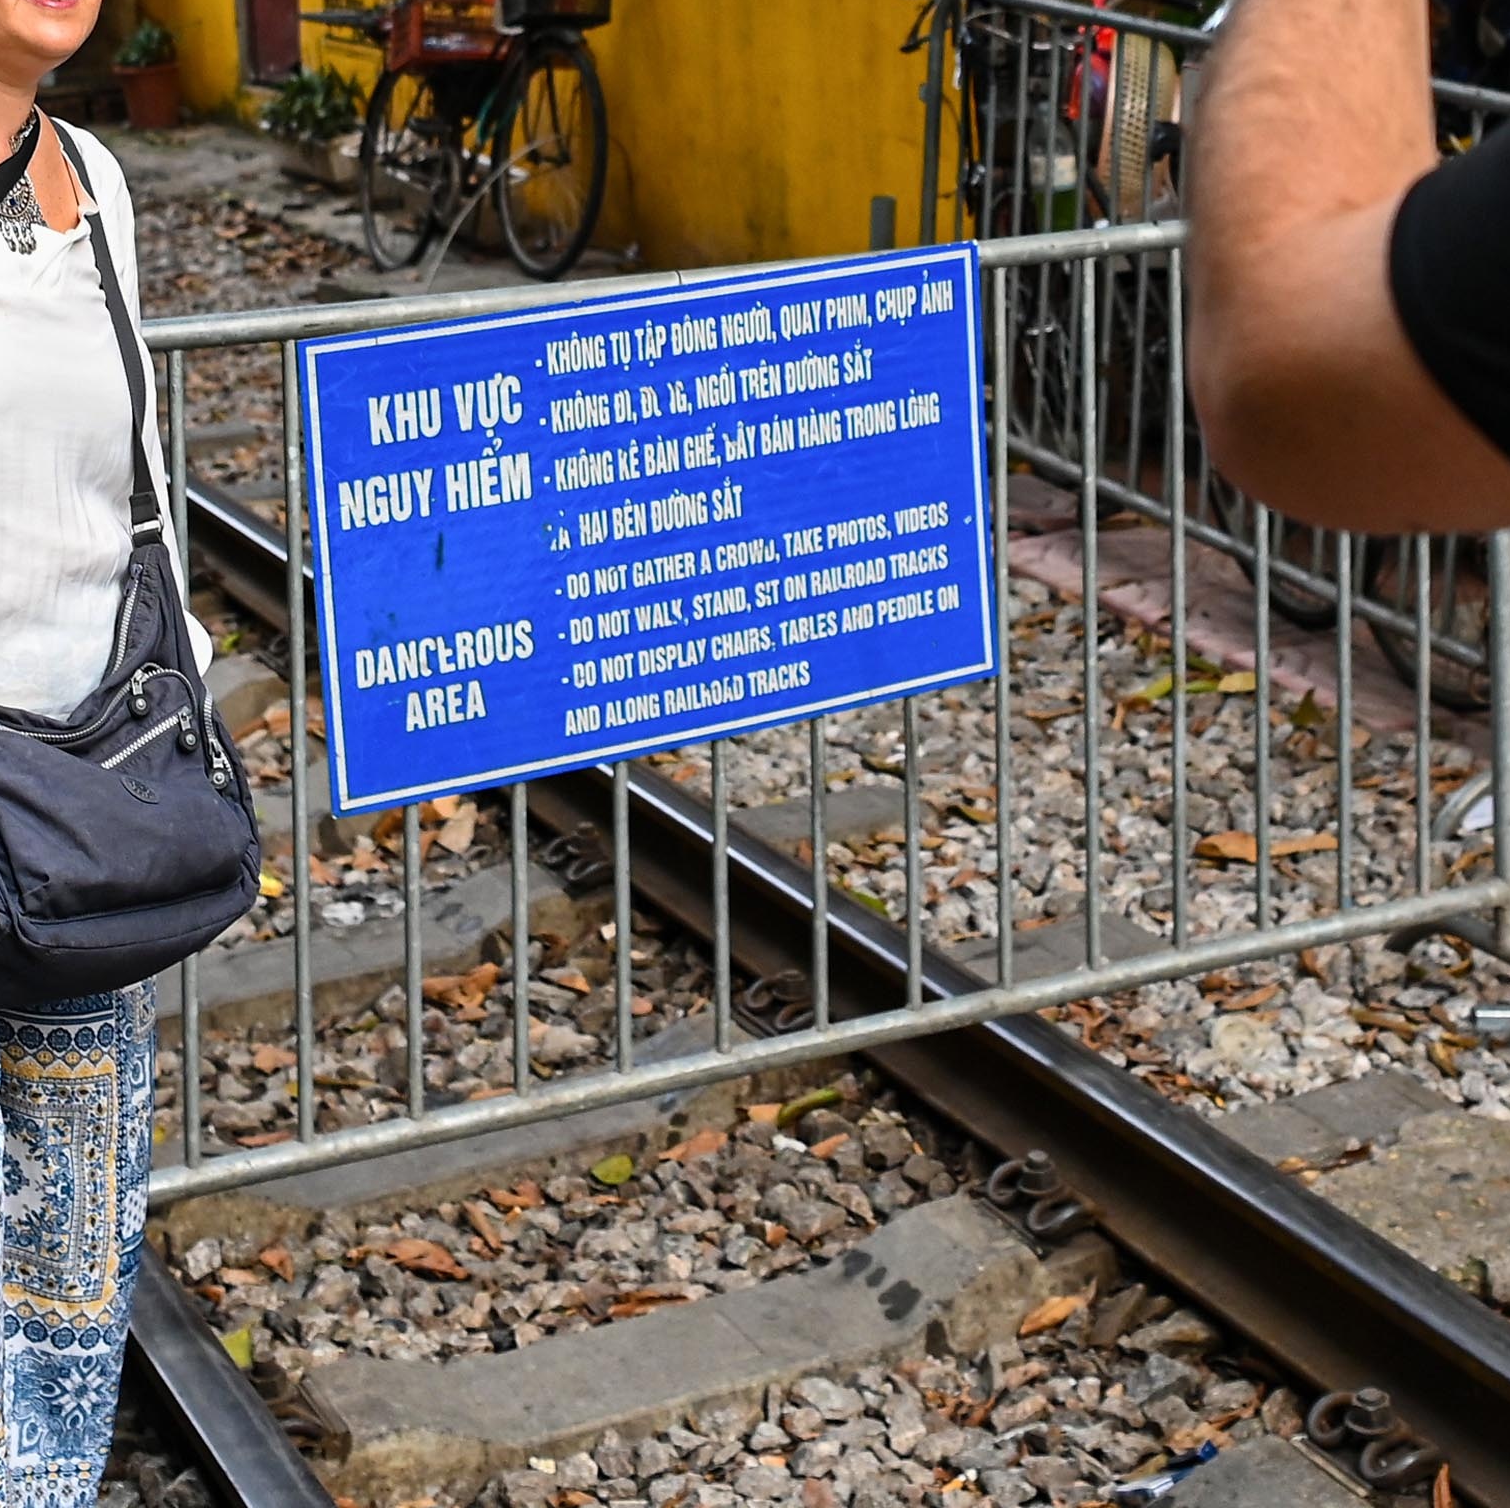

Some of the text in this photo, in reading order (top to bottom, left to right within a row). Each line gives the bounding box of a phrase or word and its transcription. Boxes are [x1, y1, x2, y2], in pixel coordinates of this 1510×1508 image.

[546, 331, 607, 376] KHÔNG
[609, 330, 632, 371] TỤ
[634, 319, 667, 368] TẬP
[670, 314, 718, 356] ĐÔNG
[779, 300, 822, 341] QUAY
[825, 293, 873, 331] PHIM,
[875, 285, 917, 326] CHỤP
[921, 269, 954, 315] ẢNH
[368, 372, 523, 446] KHU VỰC
[550, 389, 611, 434] KHÔNG
[695, 362, 737, 410] NGỒI
[738, 359, 782, 402] TRÊN
[784, 350, 840, 394] ĐƯỜNG
[843, 338, 873, 384] SẮT
[338, 437, 532, 531] NGUY HIỂM
[554, 447, 615, 492] KHÔNG
[643, 435, 680, 477] BÀN
[683, 422, 722, 470] GHẾ,
[759, 414, 795, 456] BÁN
[797, 407, 842, 449] HÀNG
[844, 400, 897, 440] TRONG
[899, 388, 940, 430] LÒNG
[566, 571, 591, 600] DO
[594, 564, 628, 595] NOT
[632, 551, 696, 588] GATHER
[700, 548, 713, 575] A
[782, 526, 824, 558] TAKE
[826, 513, 892, 550] PHOTOS,
[894, 501, 949, 535] VIDEOS
[578, 509, 608, 547] HAI
[612, 498, 647, 541] BÊN
[650, 488, 709, 534] ĐƯỜNG
[711, 476, 743, 522] SẮT
[569, 616, 594, 645] DO
[597, 608, 631, 640] NOT
[692, 586, 752, 621] STAND,
[783, 573, 808, 602] ON
[810, 557, 886, 597] RAILROAD
[888, 544, 949, 580] TRACKS
[572, 660, 597, 689] DO
[600, 652, 634, 684] NOT
[637, 638, 707, 677] DISPLAY
[778, 610, 838, 646] TABLES
[841, 603, 874, 634] AND
[877, 589, 935, 626] PEDDLE
[937, 584, 960, 612] ON
[406, 680, 486, 732] AREA
[565, 704, 601, 737] AND
[605, 693, 661, 728] ALONG
[747, 660, 811, 697] TRACKS
